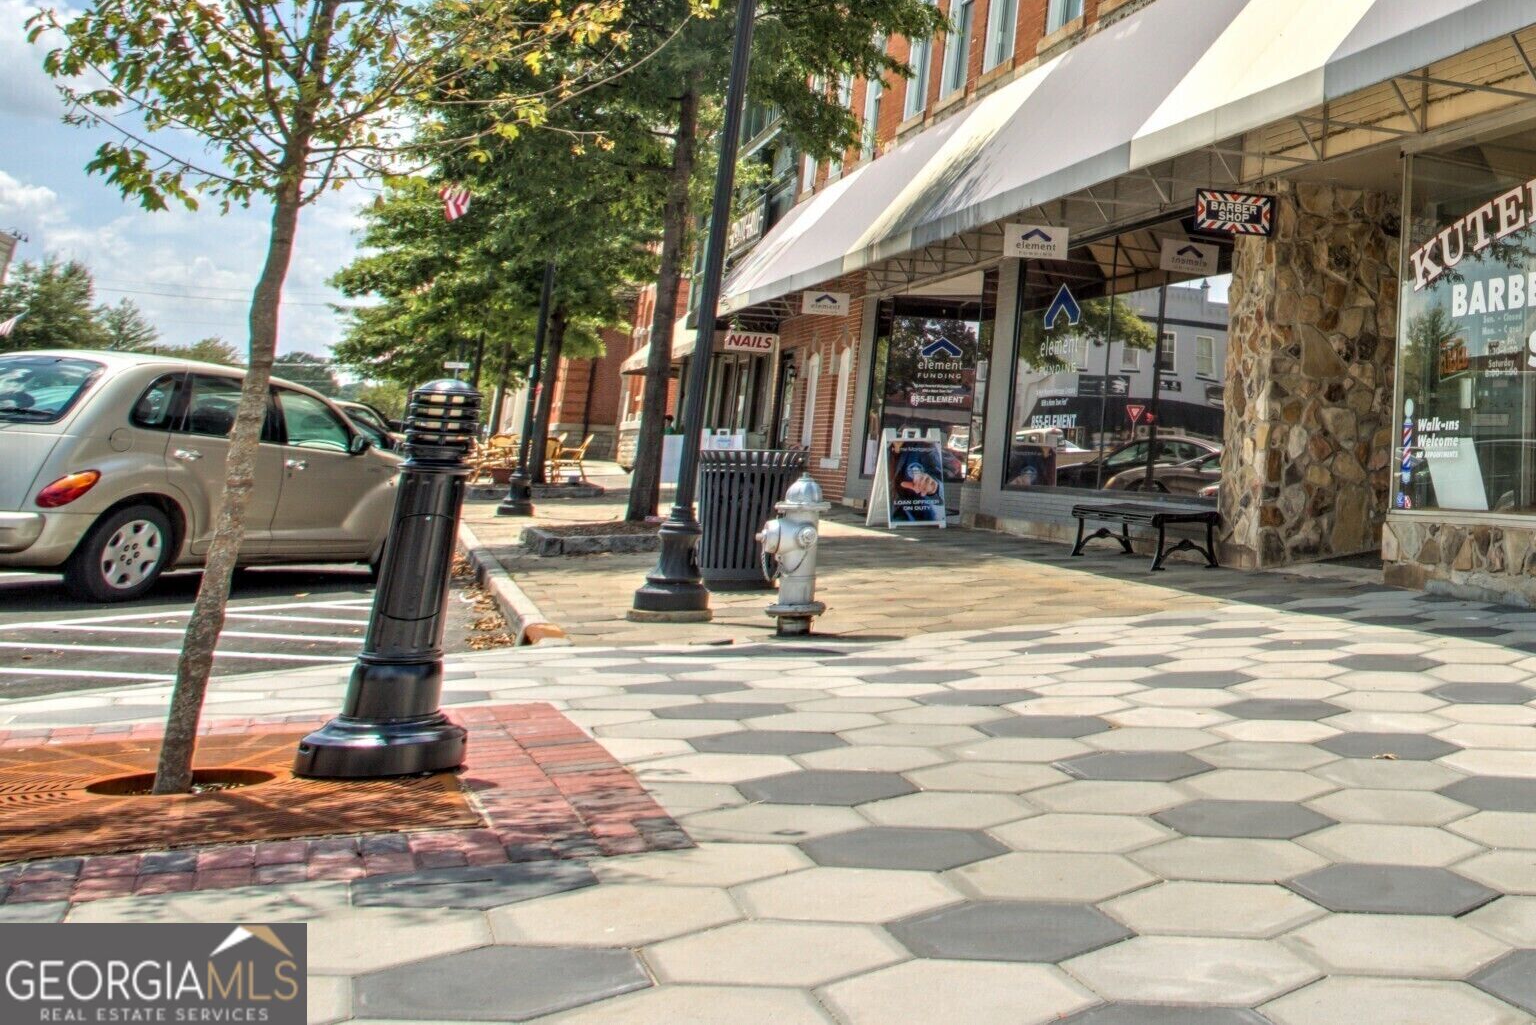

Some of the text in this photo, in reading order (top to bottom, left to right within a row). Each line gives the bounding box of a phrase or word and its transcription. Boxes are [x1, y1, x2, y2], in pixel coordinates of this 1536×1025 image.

[1210, 201, 1257, 215] BARBER
[1218, 211, 1250, 223] SHOP
[1016, 240, 1056, 252] element
[728, 334, 773, 349] NAILS
[1040, 335, 1079, 357] element
[917, 357, 963, 370] element
[1488, 357, 1515, 370] Saturday
[911, 395, 964, 404] 855-ELEMENT
[1031, 414, 1078, 429] 855-ELEMENT
[1417, 417, 1460, 432] Walk-ins
[1417, 433, 1459, 448] Welcome
